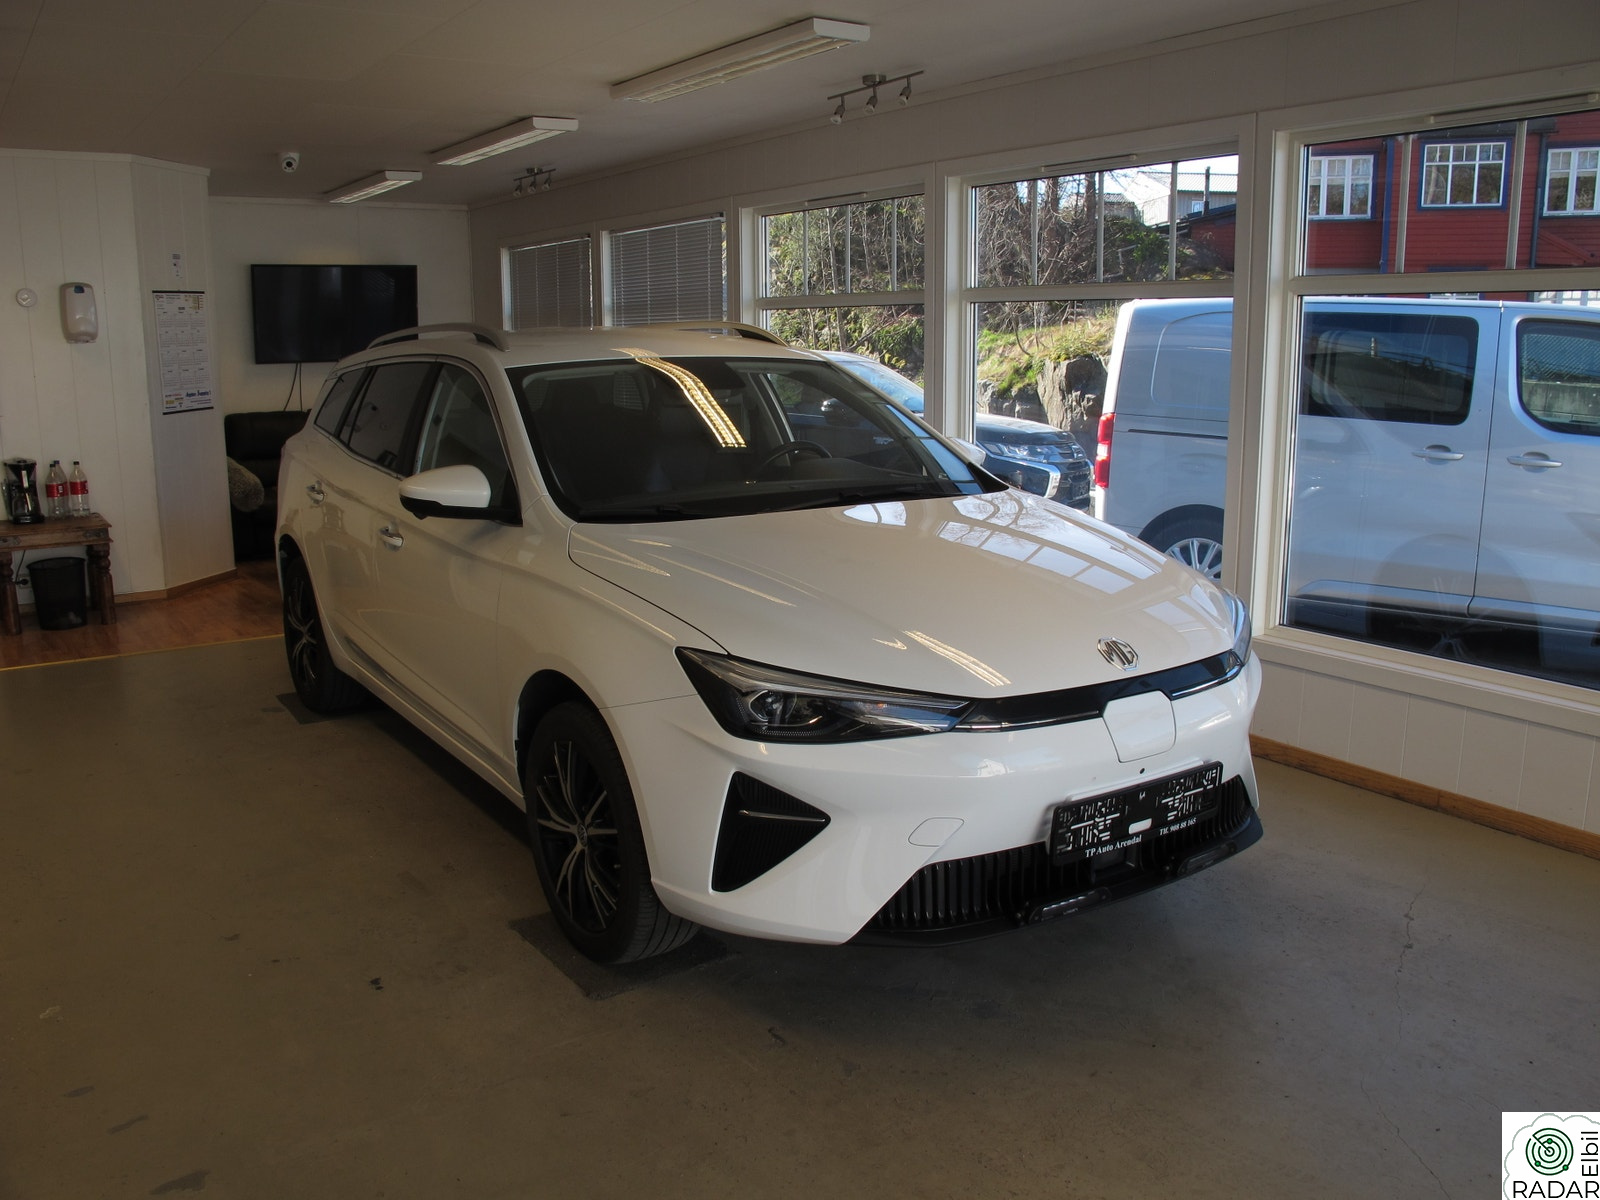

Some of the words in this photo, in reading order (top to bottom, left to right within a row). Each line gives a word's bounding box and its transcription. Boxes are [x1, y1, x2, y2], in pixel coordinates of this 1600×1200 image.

[1100, 638, 1136, 668] MG
[1085, 847, 1096, 858] TP
[1096, 846, 1114, 855] Auto
[1114, 834, 1142, 850] Arendal
